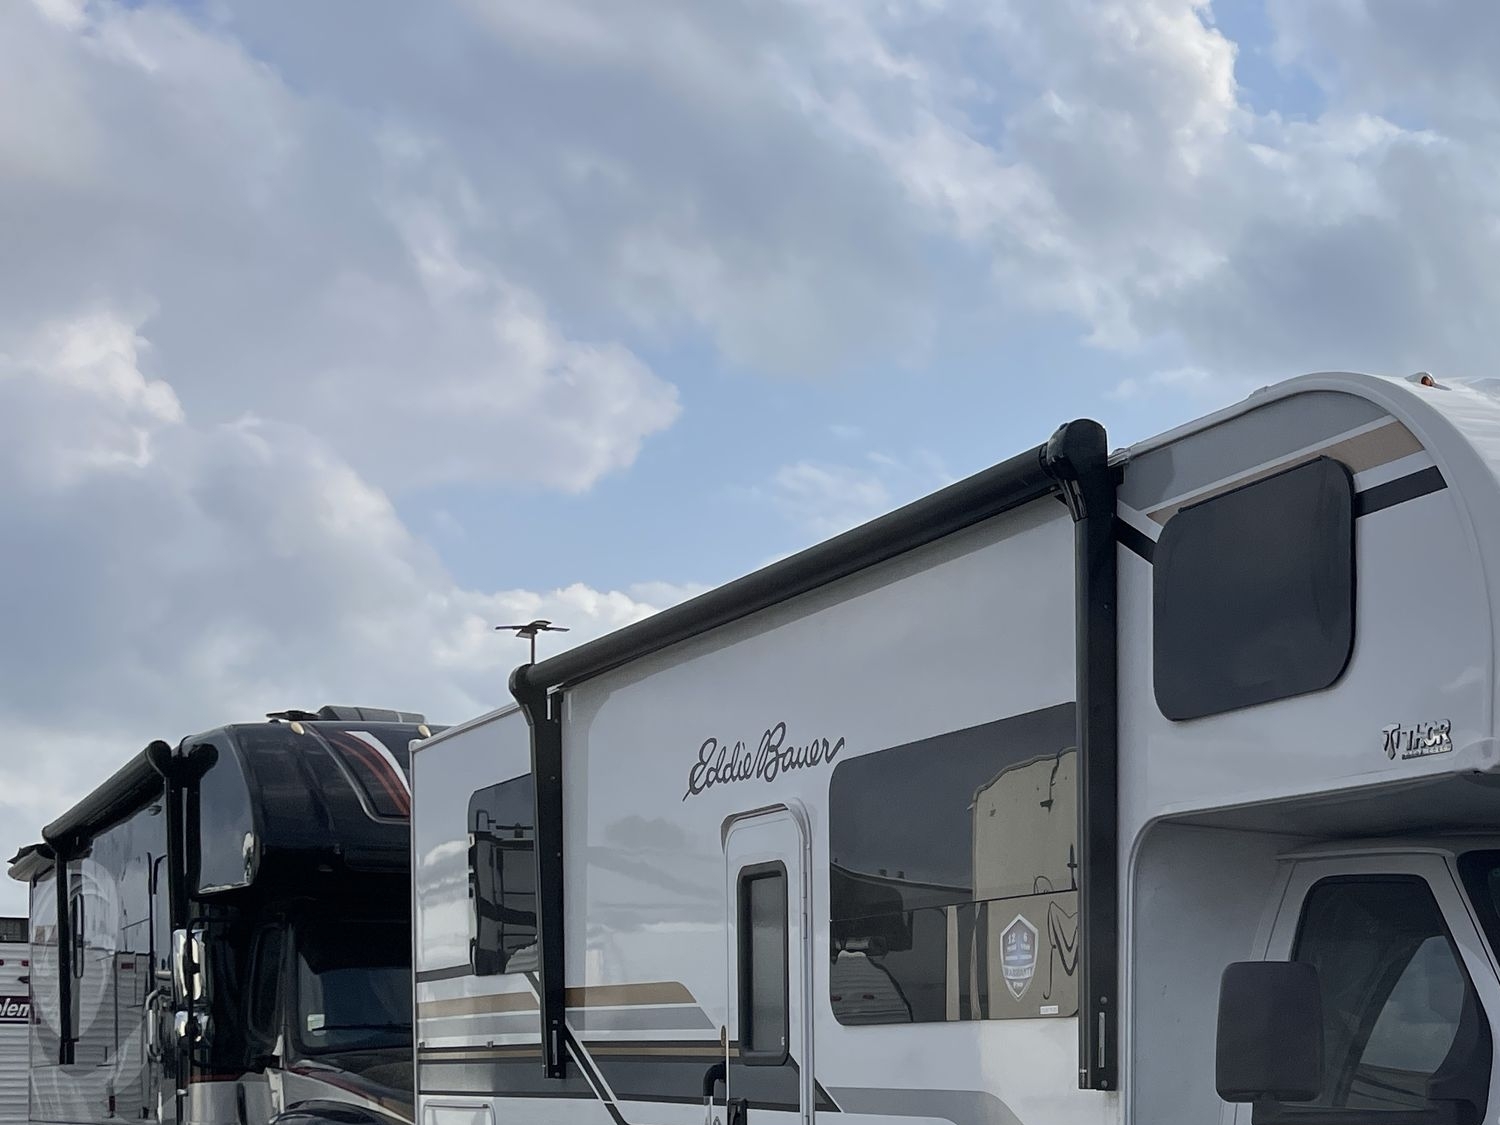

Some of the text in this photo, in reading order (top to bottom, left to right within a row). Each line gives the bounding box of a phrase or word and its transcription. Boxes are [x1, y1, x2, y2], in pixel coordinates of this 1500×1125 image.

[682, 721, 845, 801] Eddie Bauer
[1402, 719, 1451, 751] THOR
